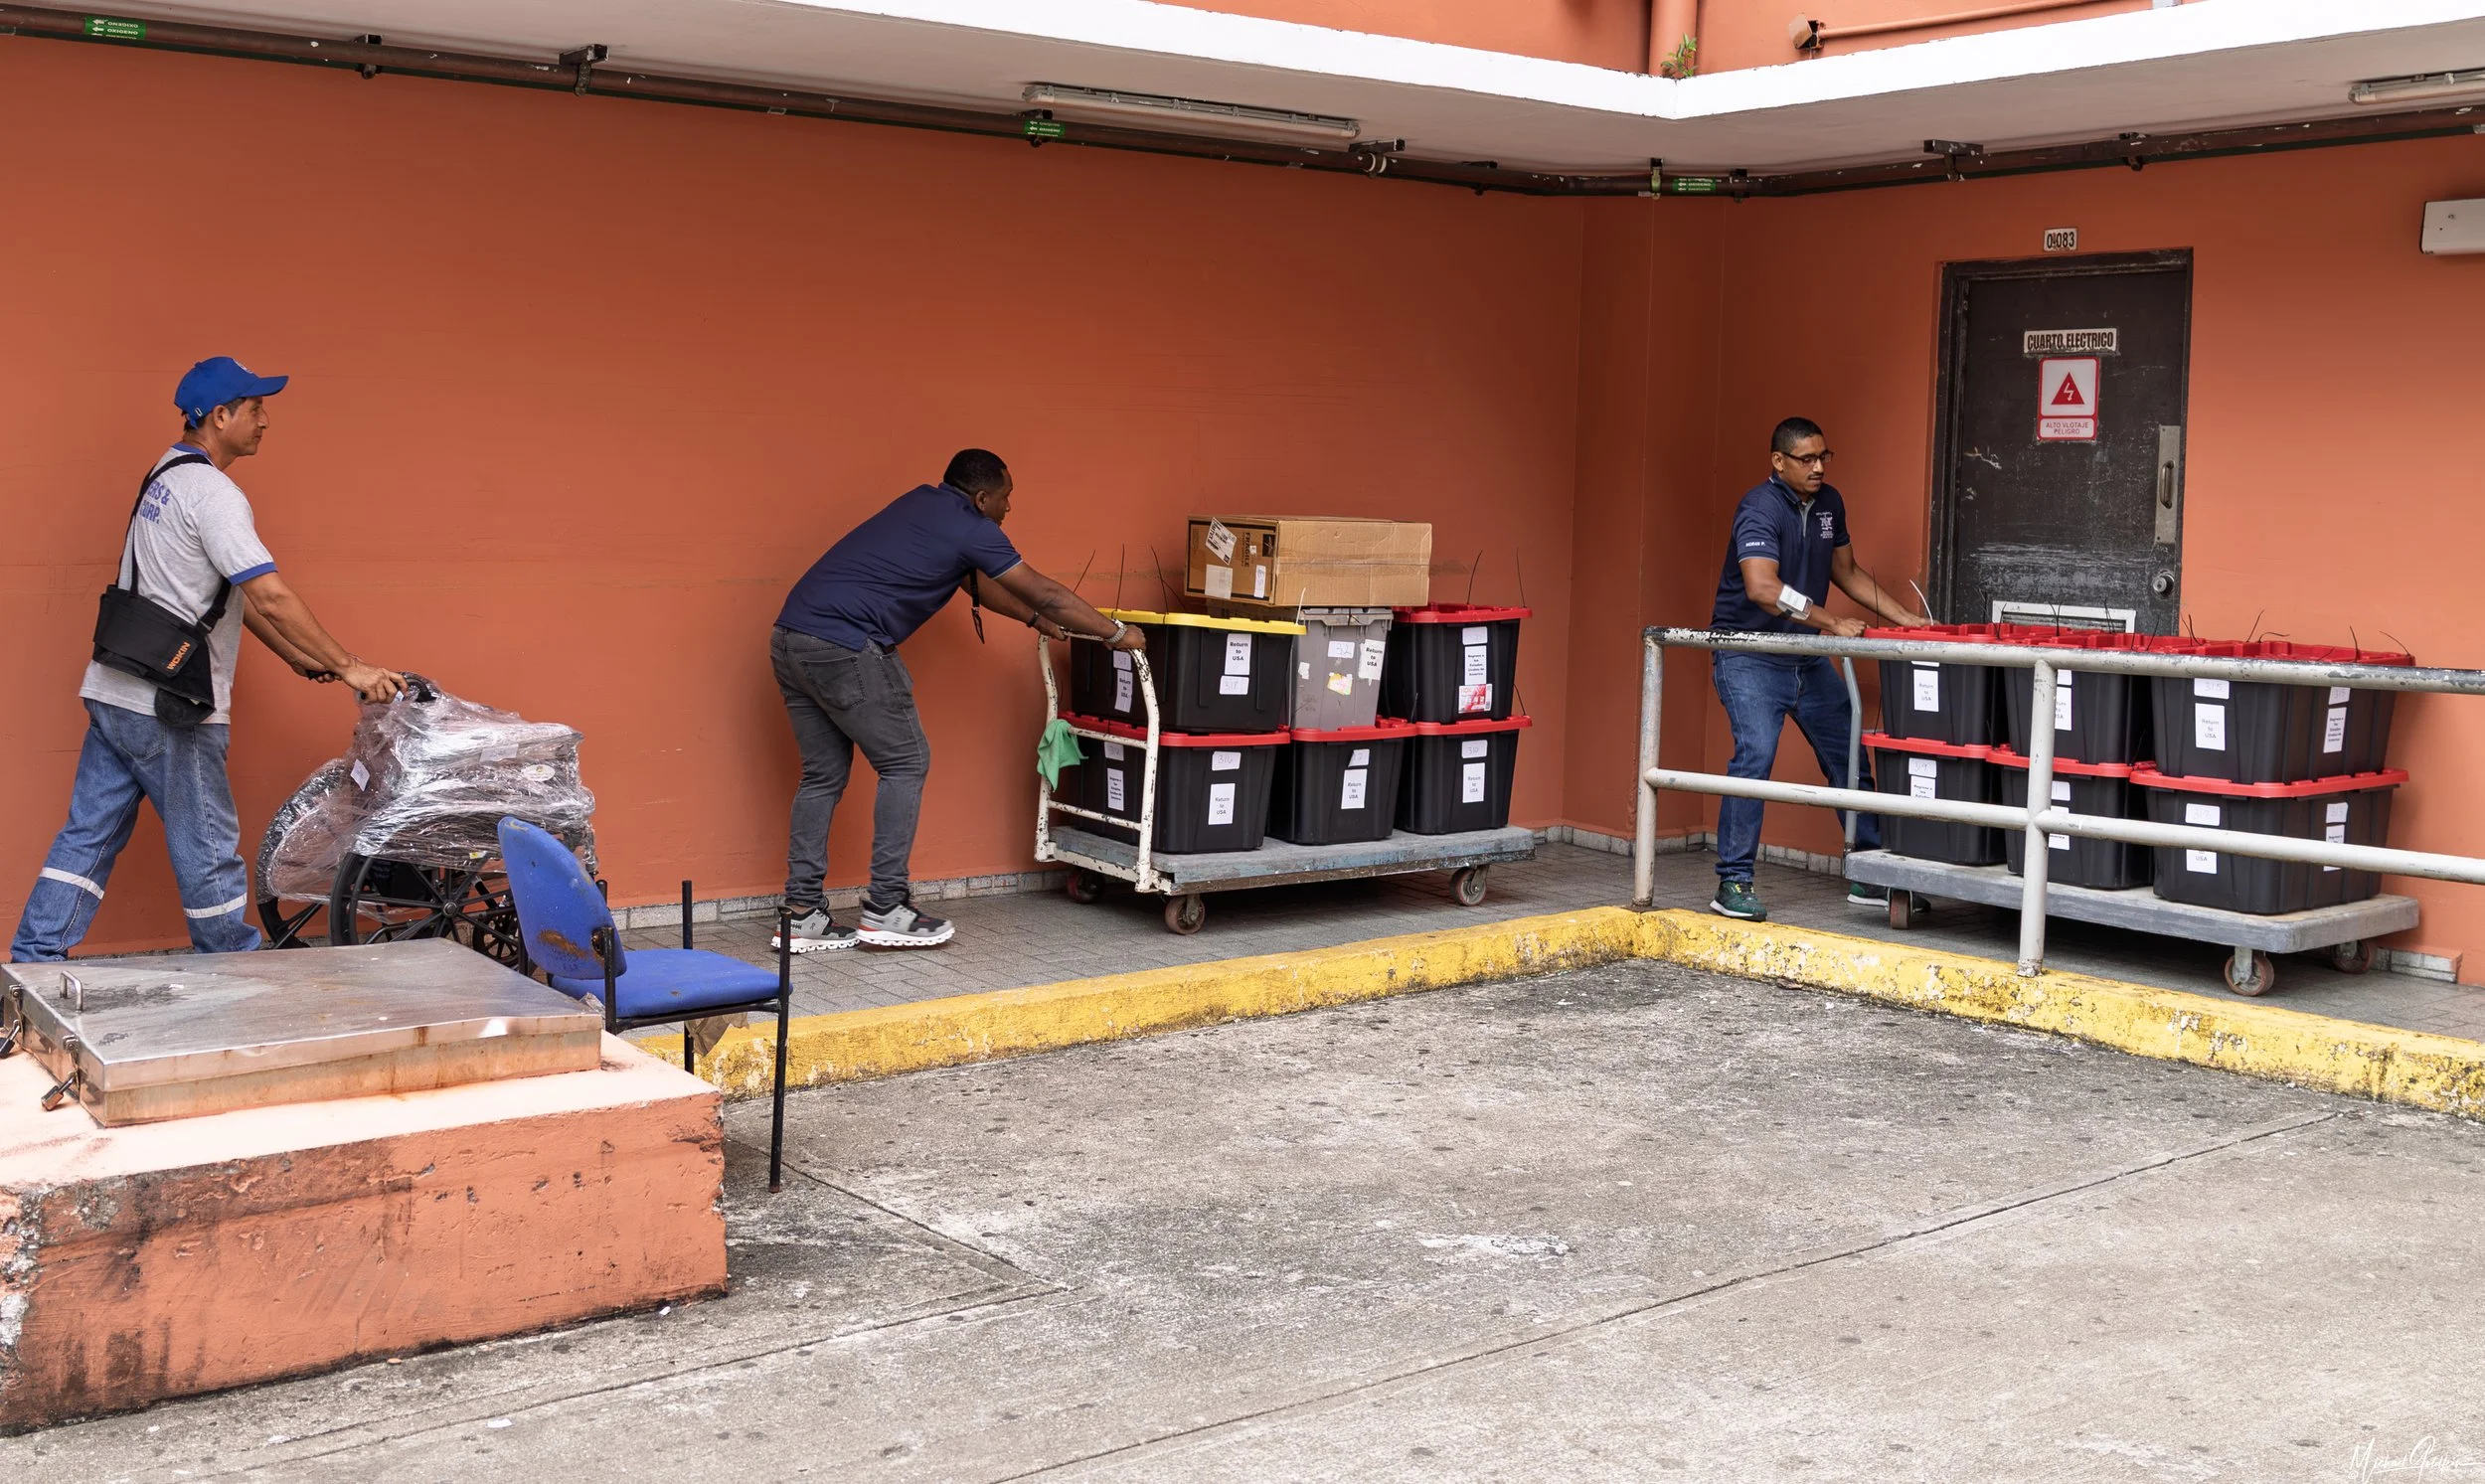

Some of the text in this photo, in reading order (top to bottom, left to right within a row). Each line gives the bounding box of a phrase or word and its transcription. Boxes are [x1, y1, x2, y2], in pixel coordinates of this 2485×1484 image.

[2028, 331, 2114, 350] CUARTO ELECTRICO
[147, 480, 171, 505] ERS &
[166, 641, 190, 669] WOKIN
